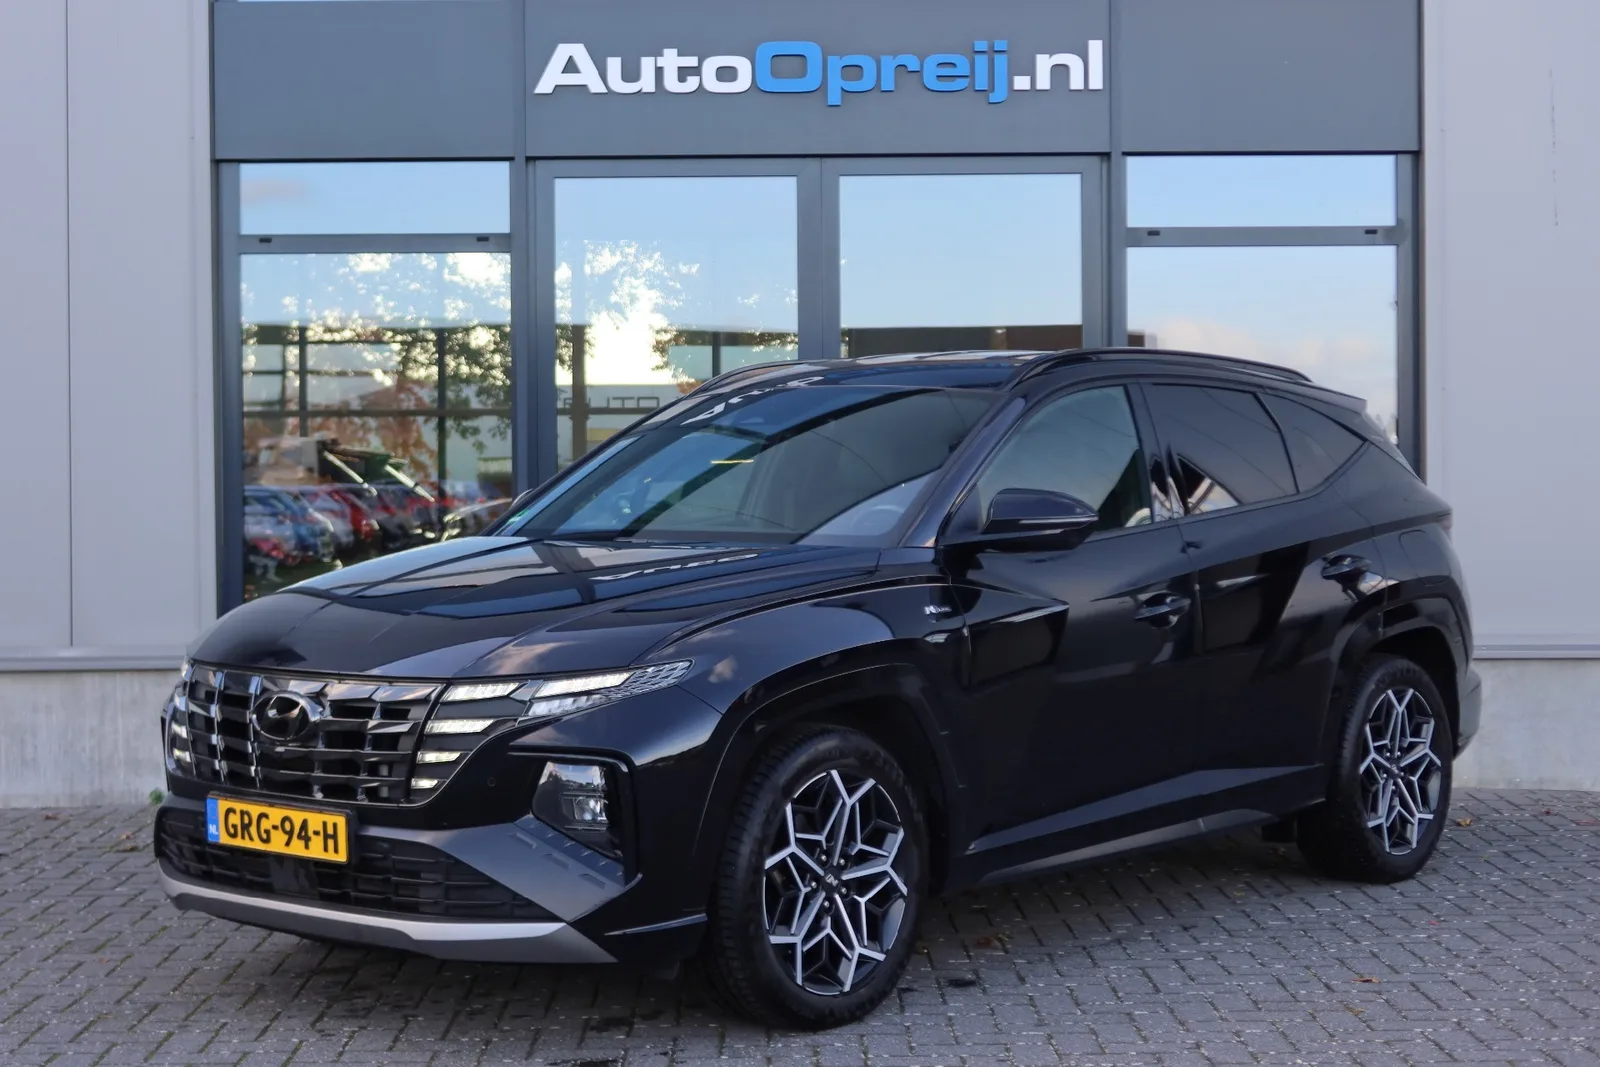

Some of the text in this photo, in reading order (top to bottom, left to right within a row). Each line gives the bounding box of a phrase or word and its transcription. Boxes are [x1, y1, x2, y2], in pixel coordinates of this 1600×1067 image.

[533, 39, 1104, 107] AutoOpreij.nl
[208, 823, 219, 835] NL
[224, 807, 339, 854] GRG-94-H
